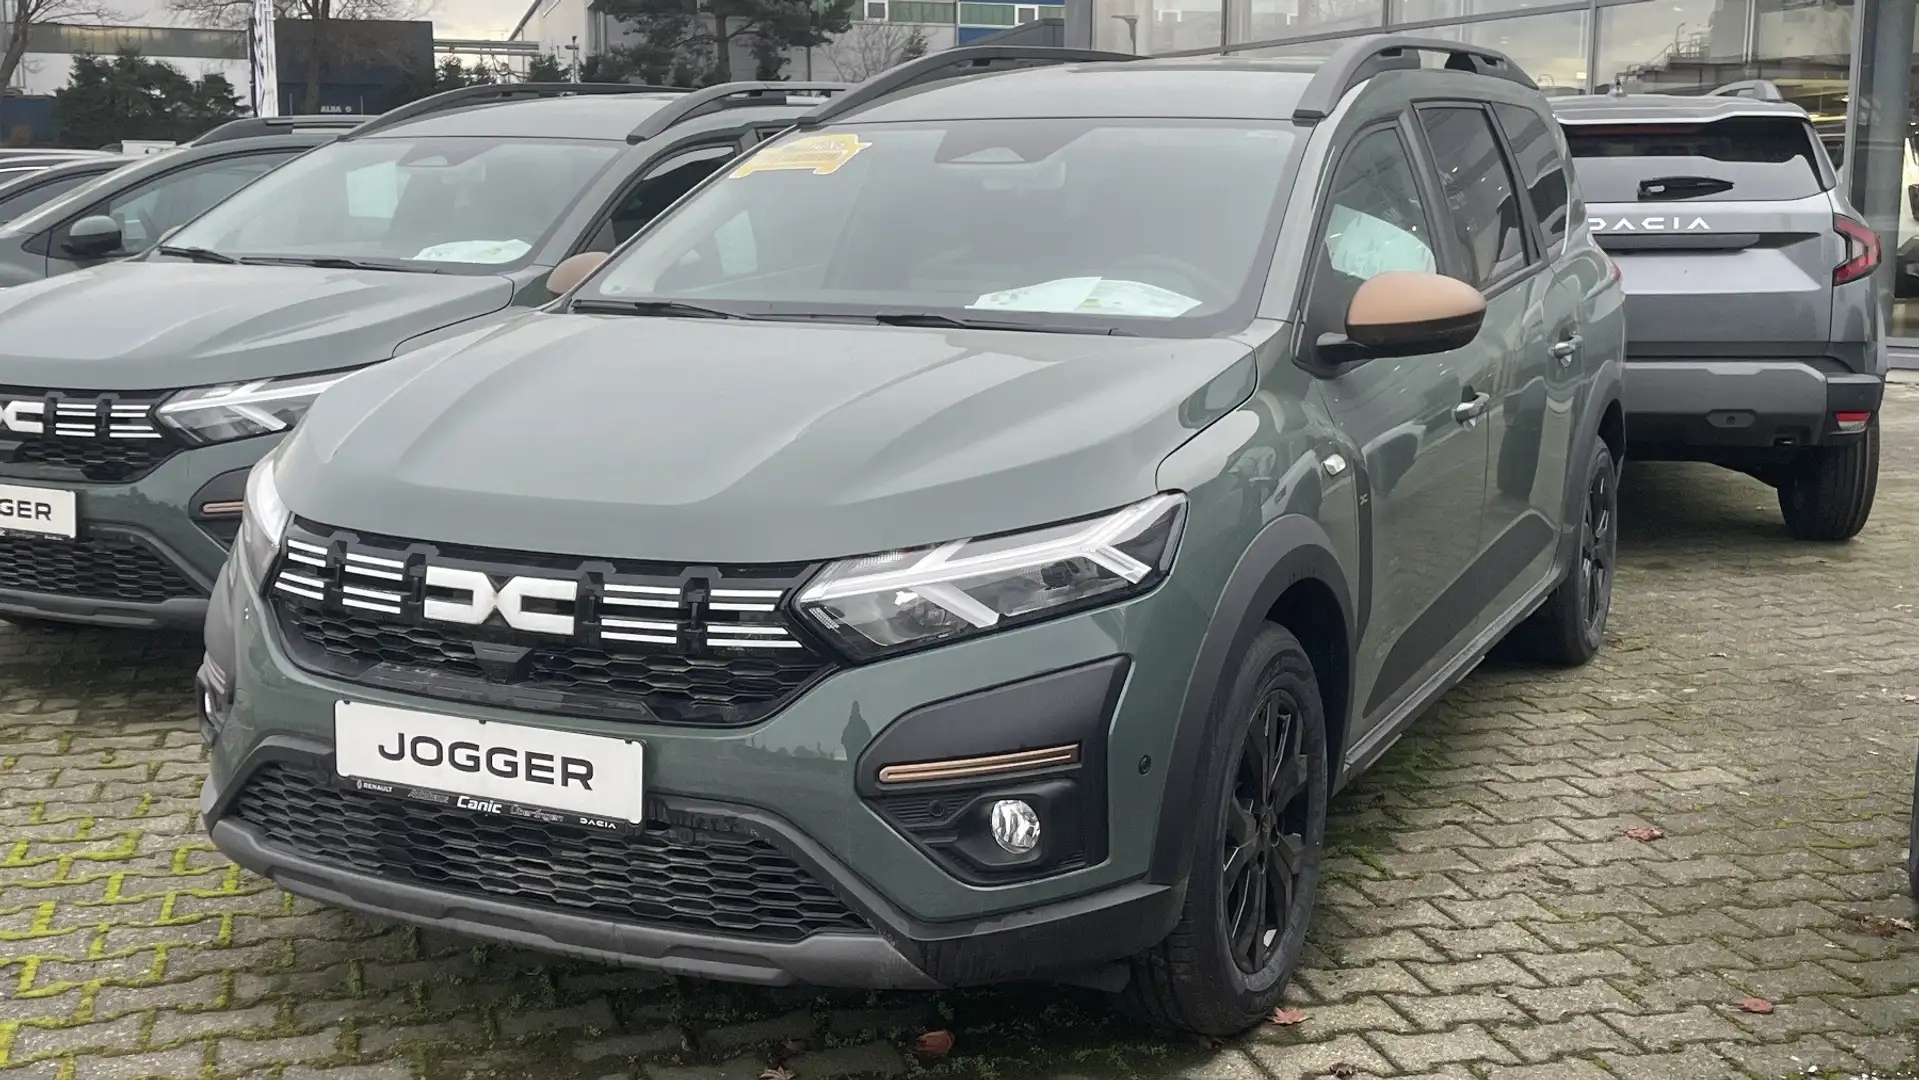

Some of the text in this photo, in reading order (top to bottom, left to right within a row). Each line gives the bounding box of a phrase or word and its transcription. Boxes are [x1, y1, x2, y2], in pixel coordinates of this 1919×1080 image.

[1588, 216, 1711, 231] DACIA
[378, 732, 594, 791] JOGGER
[456, 796, 502, 814] Canic
[580, 817, 616, 830] DACIA
